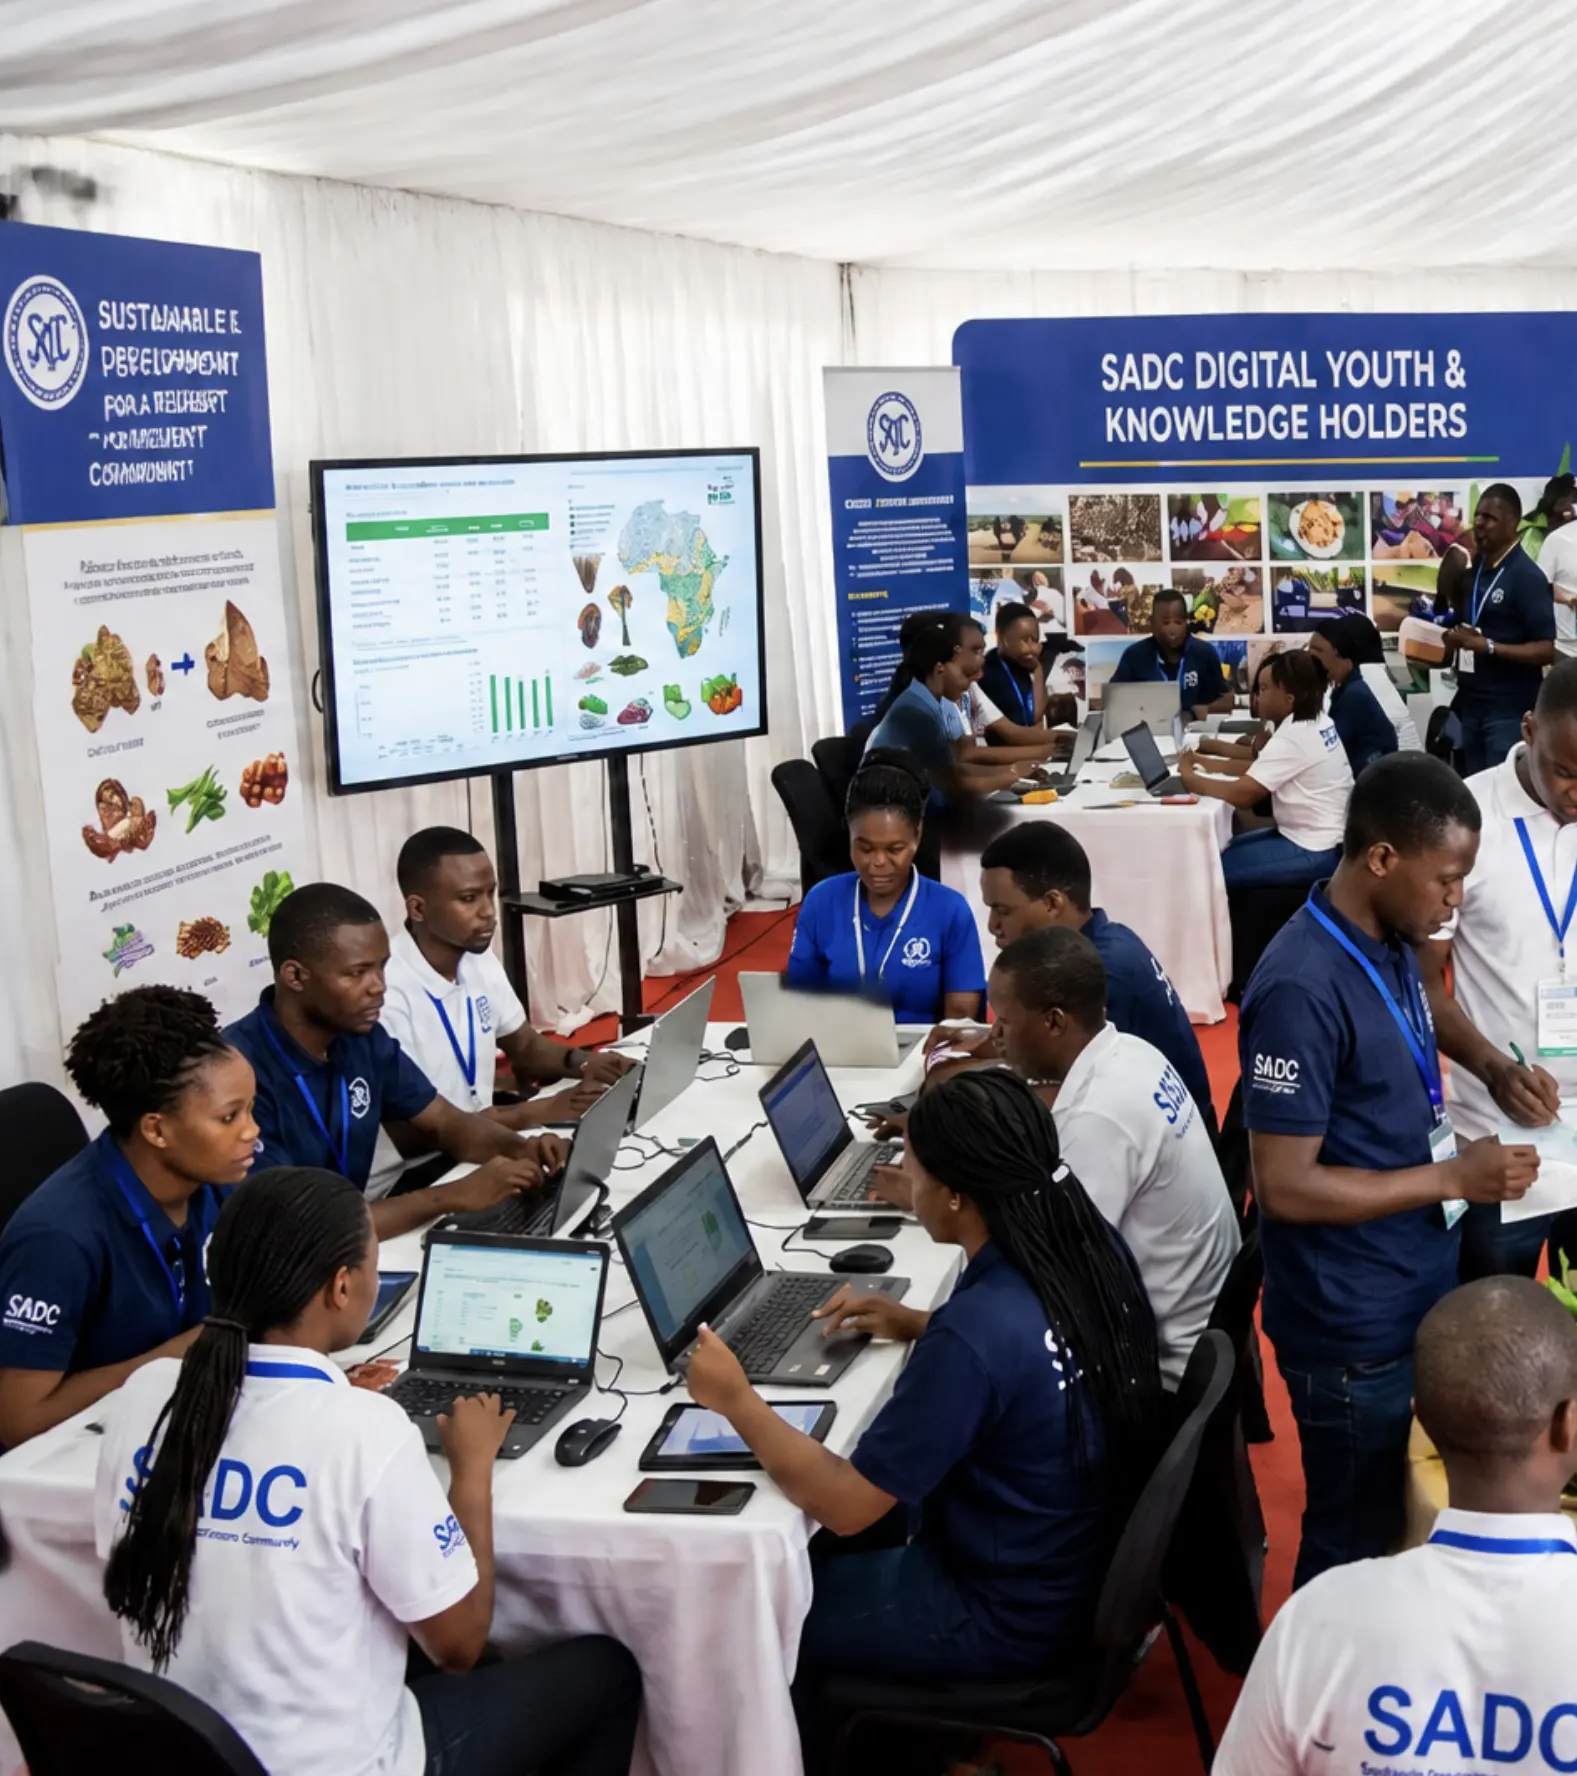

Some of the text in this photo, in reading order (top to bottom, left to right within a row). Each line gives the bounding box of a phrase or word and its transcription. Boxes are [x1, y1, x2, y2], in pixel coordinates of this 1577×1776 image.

[1101, 350, 1467, 391] SADC DIGITAL YOUTH &
[1106, 403, 1468, 442] KNOWLEDGE HOLDERS
[1254, 1053, 1299, 1081] SADC
[5, 1294, 61, 1325] SADC
